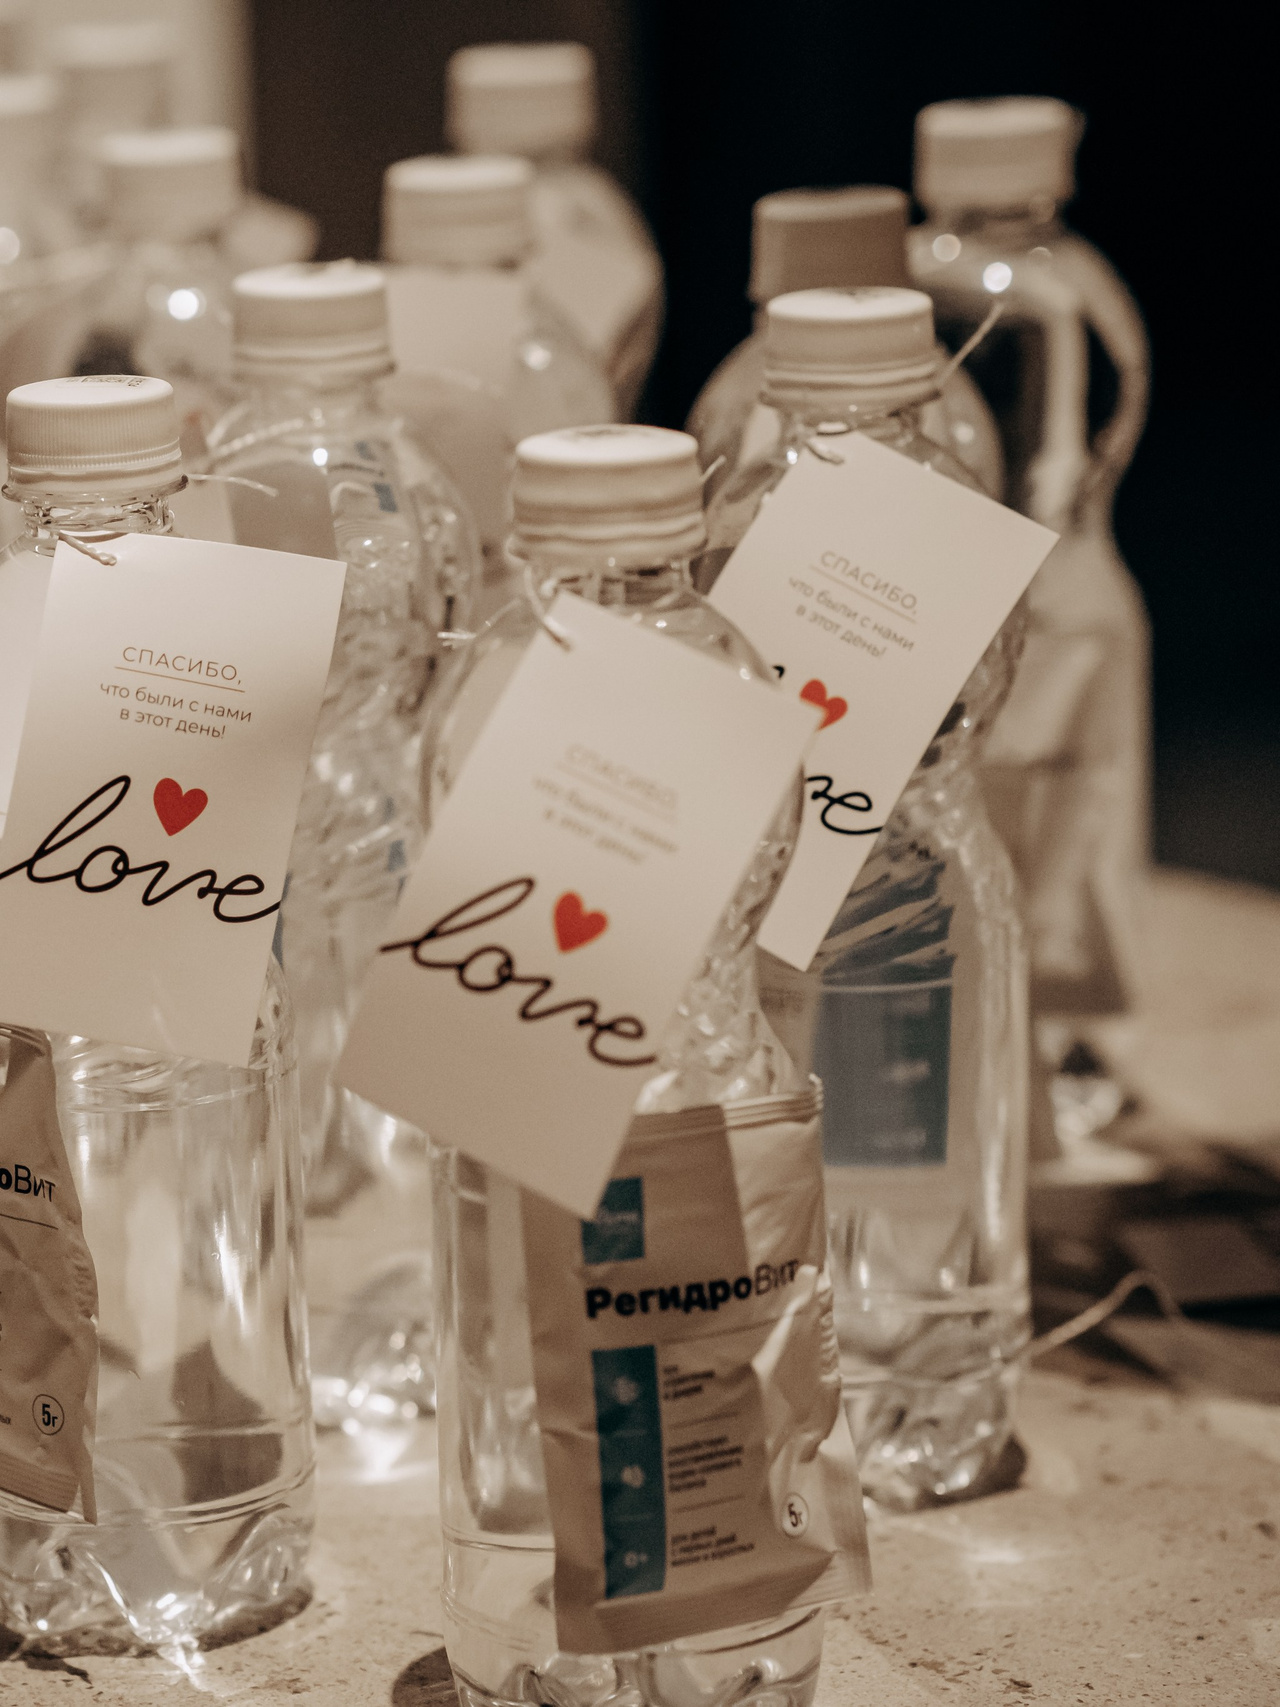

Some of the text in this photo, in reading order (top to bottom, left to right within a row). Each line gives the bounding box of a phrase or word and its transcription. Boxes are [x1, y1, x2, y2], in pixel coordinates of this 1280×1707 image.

[122, 646, 242, 685] СПАСИБО,
[100, 682, 252, 723] что были с нами
[120, 708, 227, 739] в этот день!
[379, 876, 658, 1067] love
[586, 1259, 799, 1319] РегидроВит
[41, 1403, 59, 1428] 5г
